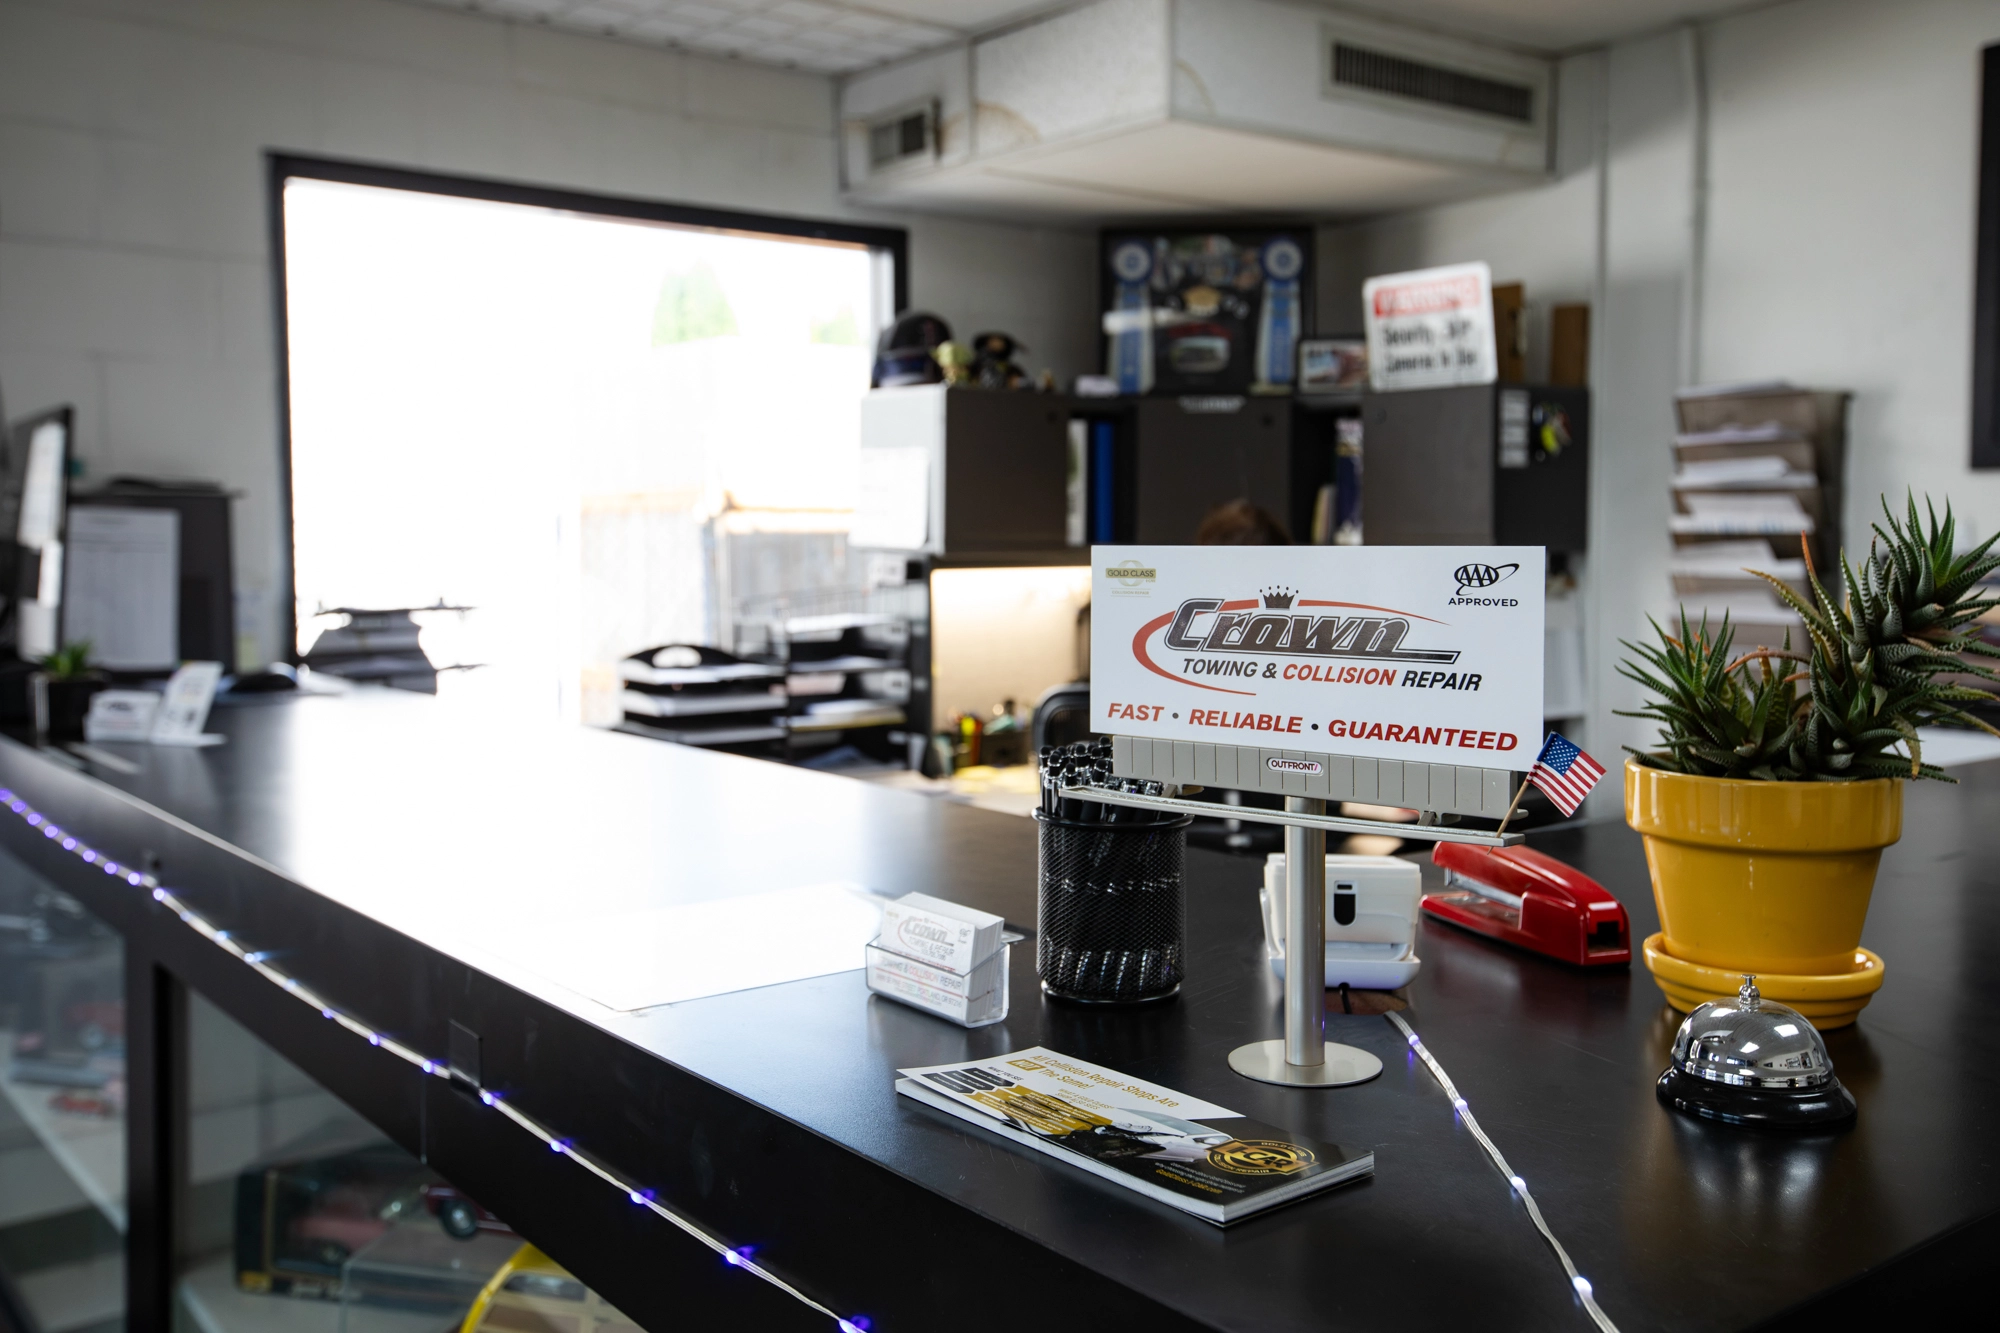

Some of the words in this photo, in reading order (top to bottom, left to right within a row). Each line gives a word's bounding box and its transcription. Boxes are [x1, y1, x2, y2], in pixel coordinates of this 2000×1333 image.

[1107, 569, 1129, 577] GOLD
[1130, 569, 1154, 578] CLASS
[1457, 564, 1497, 587] AAA
[1448, 597, 1519, 607] APPROVED
[1164, 598, 1461, 664] Crown
[1183, 658, 1258, 678] TOWING
[1262, 662, 1277, 679] &
[1283, 663, 1397, 686] COLLISION
[1401, 670, 1483, 692] REPAIR
[1107, 702, 1165, 722] FAST
[1188, 709, 1303, 734] RELIABLE
[1328, 719, 1518, 751] GUARANTEED
[1030, 1055, 1045, 1064] All
[1045, 1059, 1091, 1078] Collision
[1089, 1073, 1125, 1090] Repair
[1122, 1084, 1159, 1102] Shops
[1155, 1097, 1180, 1108] Are
[1038, 1069, 1061, 1080] The
[1057, 1075, 1095, 1090] Same!
[1226, 1146, 1294, 1169] I-CAR
